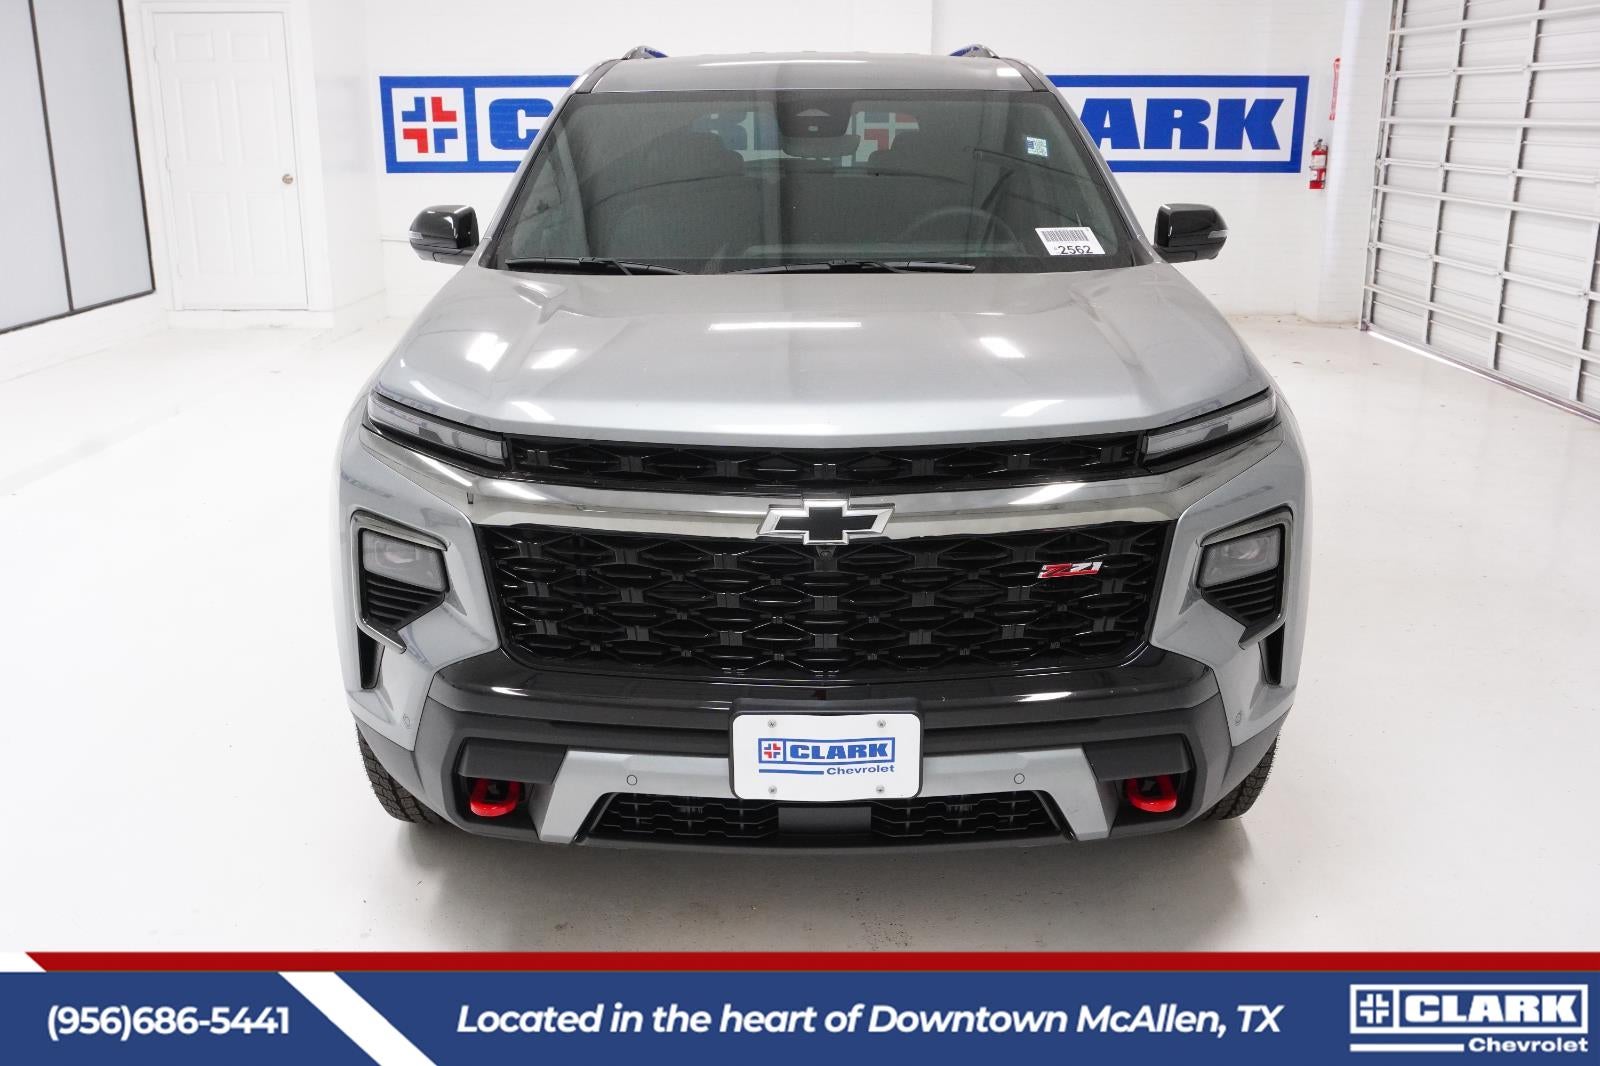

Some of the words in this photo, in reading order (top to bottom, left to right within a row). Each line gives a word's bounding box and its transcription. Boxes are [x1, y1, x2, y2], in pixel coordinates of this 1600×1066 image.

[1080, 98, 1284, 150] ARK
[1058, 245, 1093, 255] 2562
[1037, 561, 1103, 579] Z71
[789, 742, 888, 760] CLARK
[826, 764, 895, 775] Chevrolet
